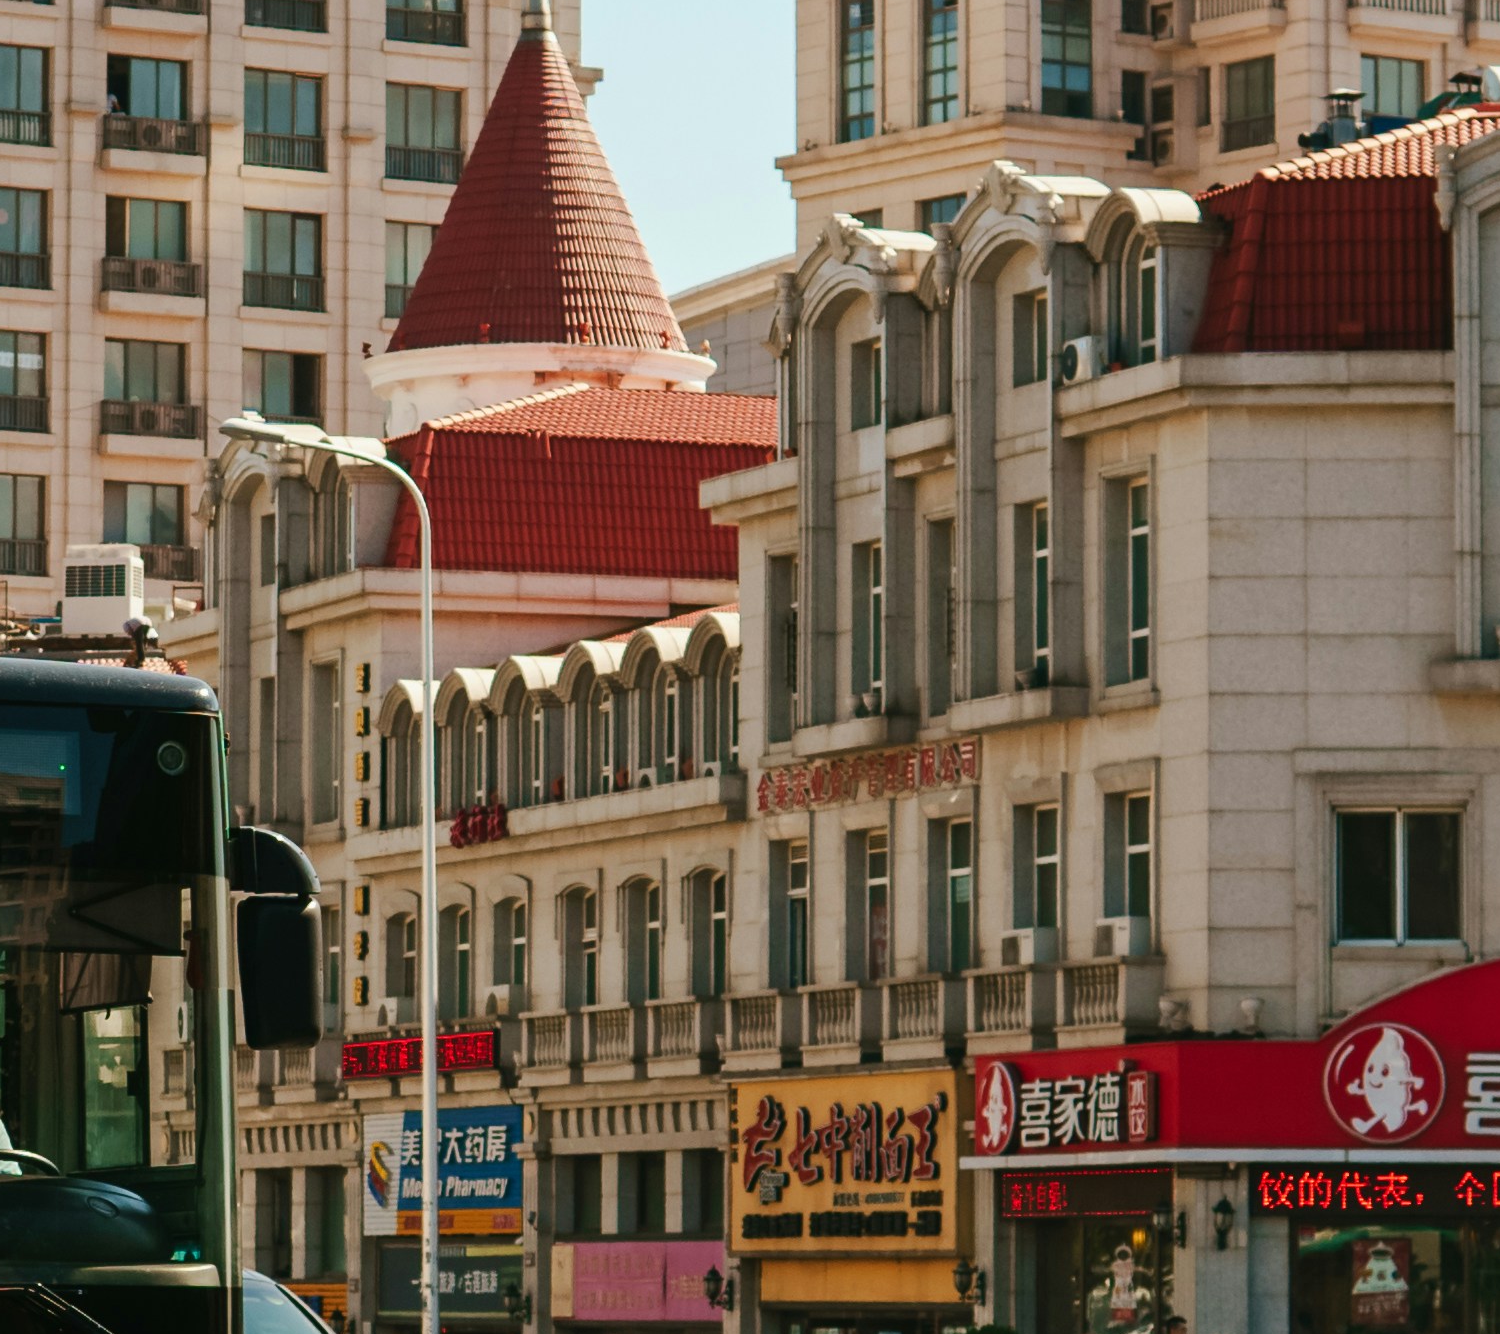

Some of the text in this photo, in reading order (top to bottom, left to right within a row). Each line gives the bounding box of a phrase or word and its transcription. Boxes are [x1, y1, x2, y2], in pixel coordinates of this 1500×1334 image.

[1020, 1072, 1121, 1148] 喜家德
[401, 1125, 507, 1166] 美大药房
[445, 1175, 509, 1199] Pharmacy
